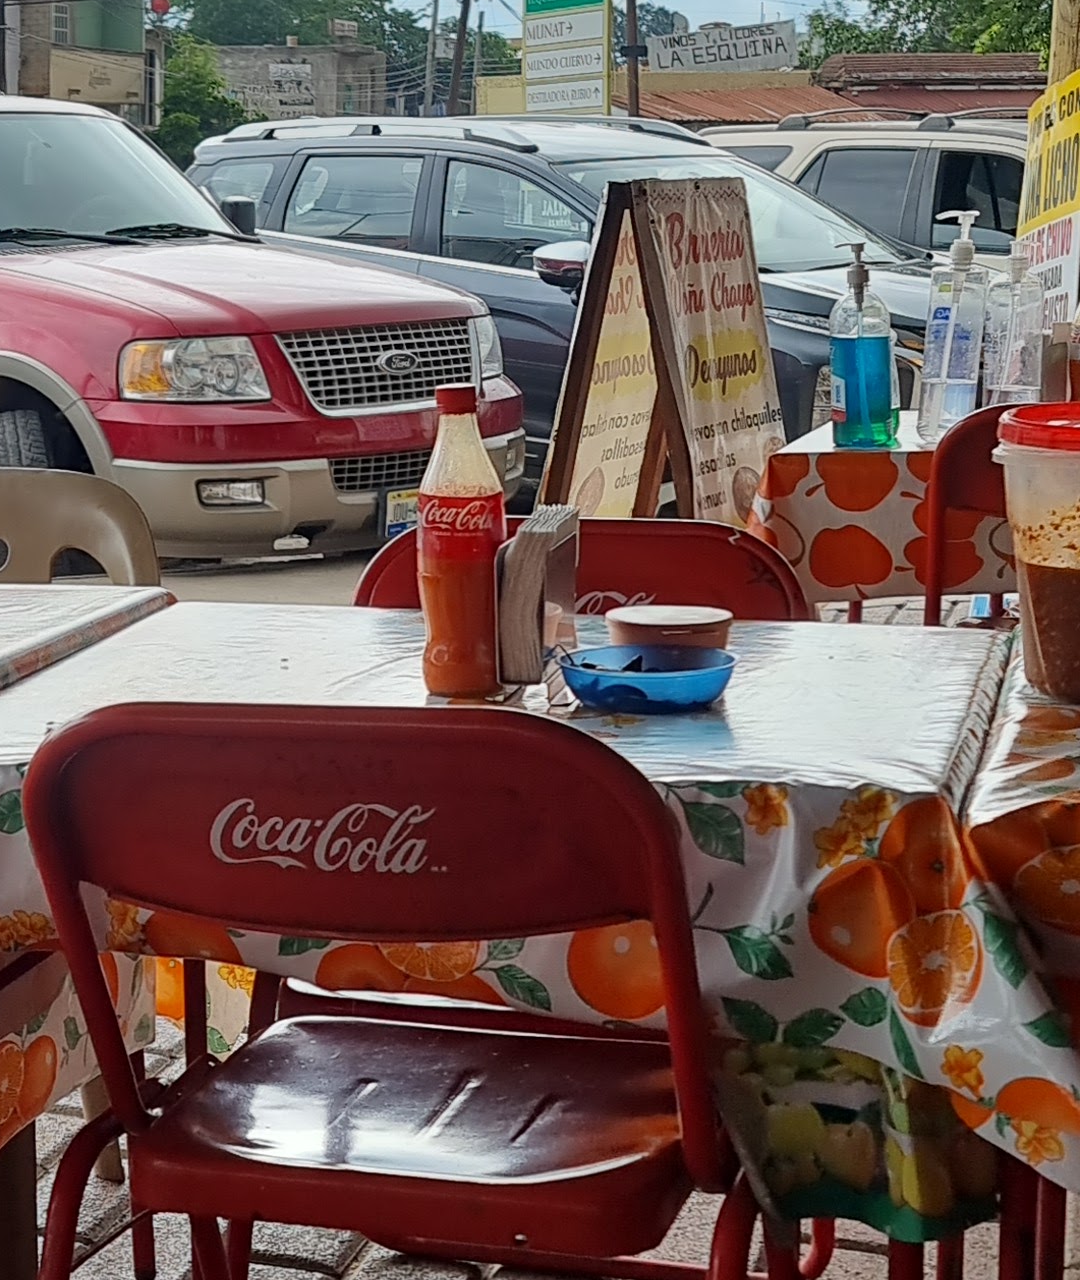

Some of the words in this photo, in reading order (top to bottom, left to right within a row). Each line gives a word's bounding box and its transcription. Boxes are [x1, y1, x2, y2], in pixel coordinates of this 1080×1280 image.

[526, 22, 565, 40] MUNAT
[661, 35, 696, 49] VINOS
[719, 24, 775, 41] LICORES
[526, 58, 558, 72] MUNDO
[560, 54, 593, 68] CUERVO
[657, 50, 684, 69] LA
[691, 37, 788, 65] ESQUINA
[527, 90, 570, 105] DESTILADORA
[571, 88, 592, 101] RUBIO
[1046, 216, 1073, 261] CHIVO
[710, 271, 756, 322] Chayo
[391, 355, 411, 368] Ford
[731, 402, 782, 432] chilaquiles
[423, 499, 495, 530] Coca-Cola
[210, 798, 436, 874] Coca-Cola
